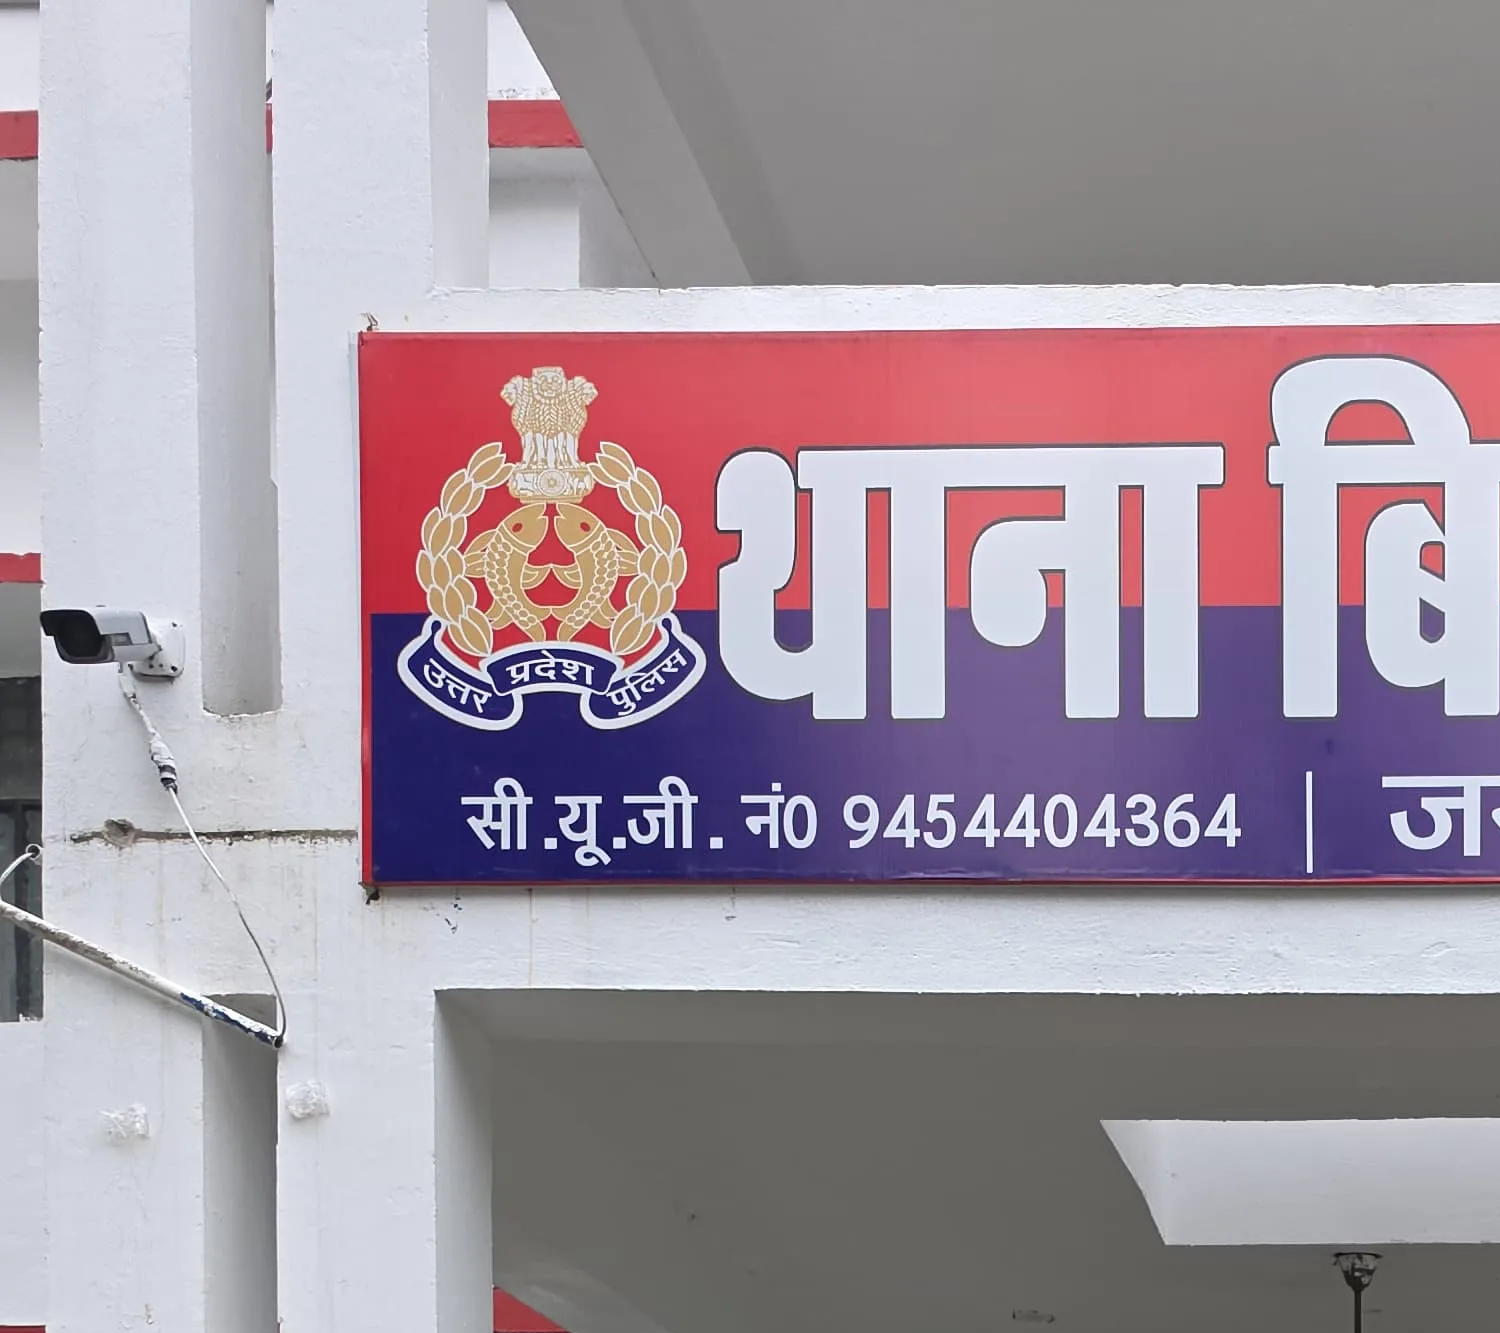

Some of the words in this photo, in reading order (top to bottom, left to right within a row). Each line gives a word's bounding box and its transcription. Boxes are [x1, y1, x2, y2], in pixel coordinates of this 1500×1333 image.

[716, 445, 1225, 720] थाना
[422, 657, 494, 714] उत्तर
[505, 649, 595, 687] प्रदेश
[608, 648, 688, 718] पुलिस
[843, 793, 1242, 849] 9454404364
